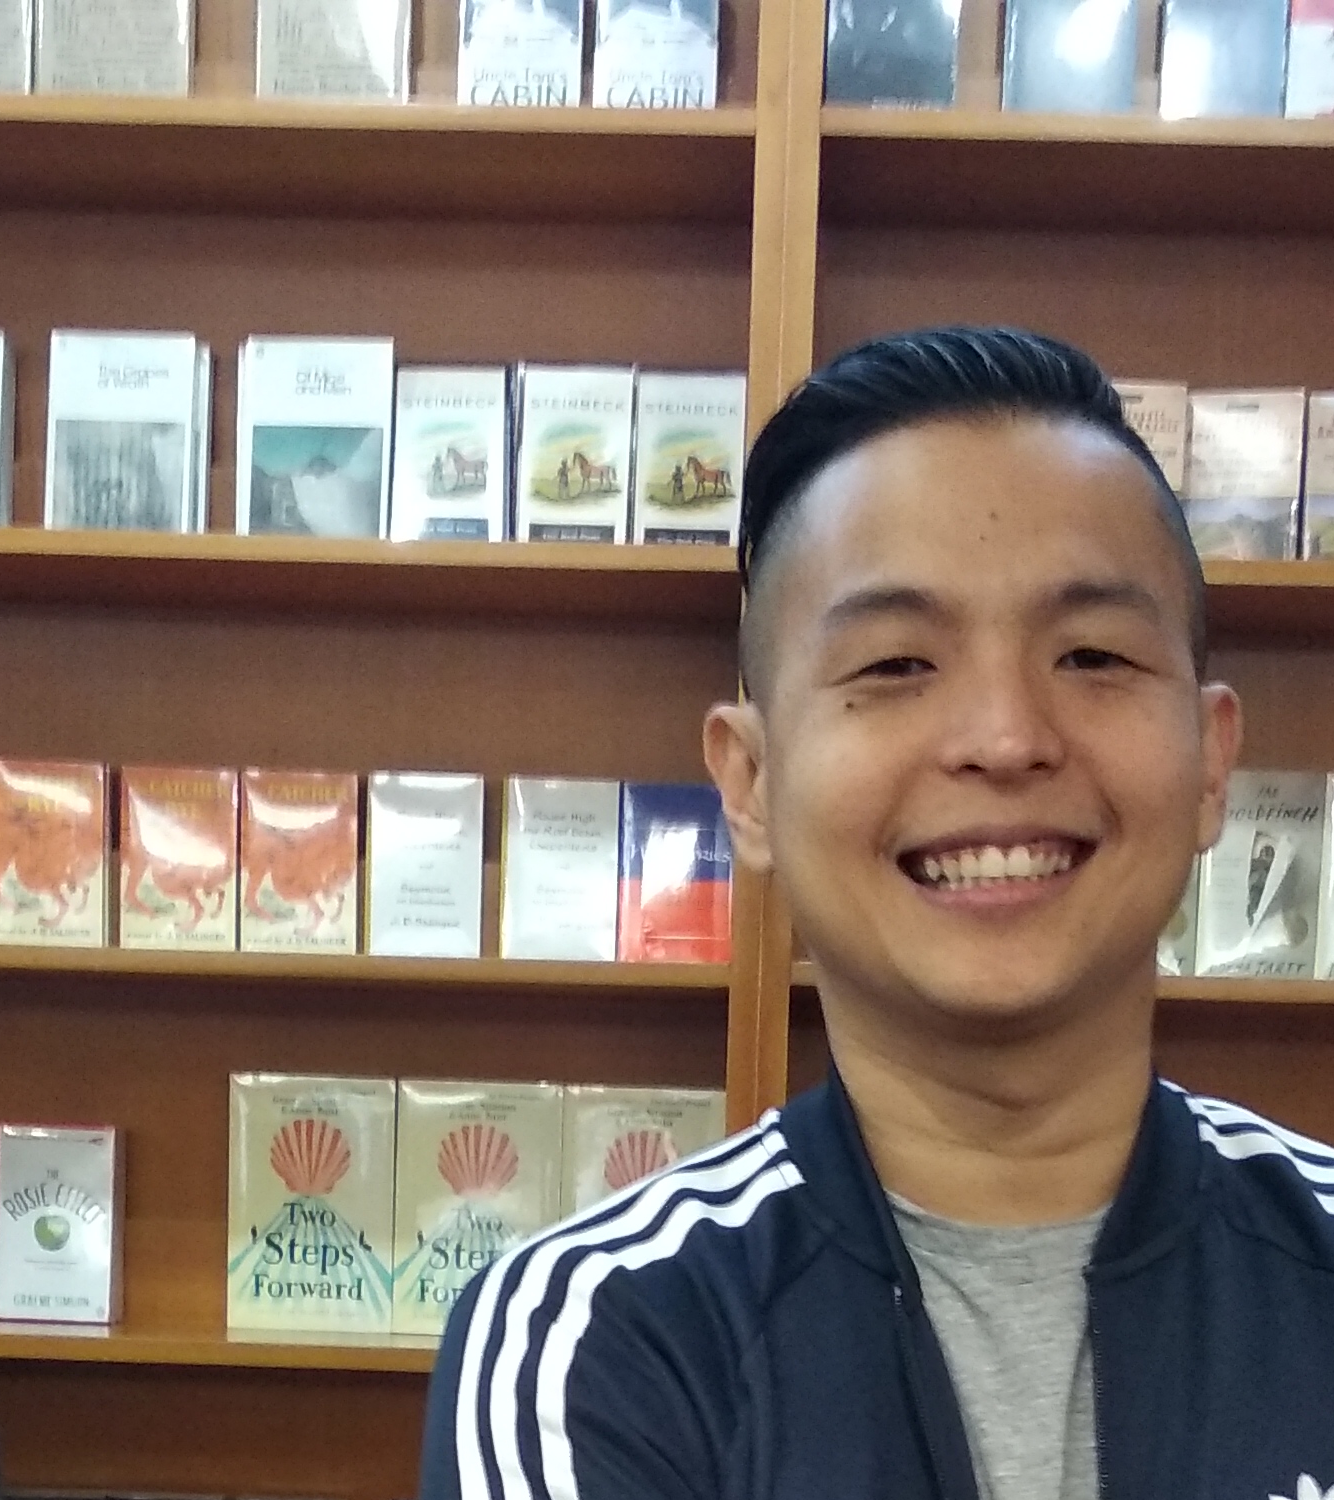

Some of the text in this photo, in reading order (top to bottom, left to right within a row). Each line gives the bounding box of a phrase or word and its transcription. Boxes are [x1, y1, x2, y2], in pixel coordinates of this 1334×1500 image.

[470, 84, 567, 108] CABIN
[607, 86, 704, 109] CABIN
[530, 397, 627, 412] STEINBECK
[644, 403, 738, 419] STEINBECK
[2, 1182, 51, 1222] ROSIE
[283, 1202, 337, 1229] Two
[265, 1232, 355, 1276] Steps
[252, 1273, 365, 1302] Forward
